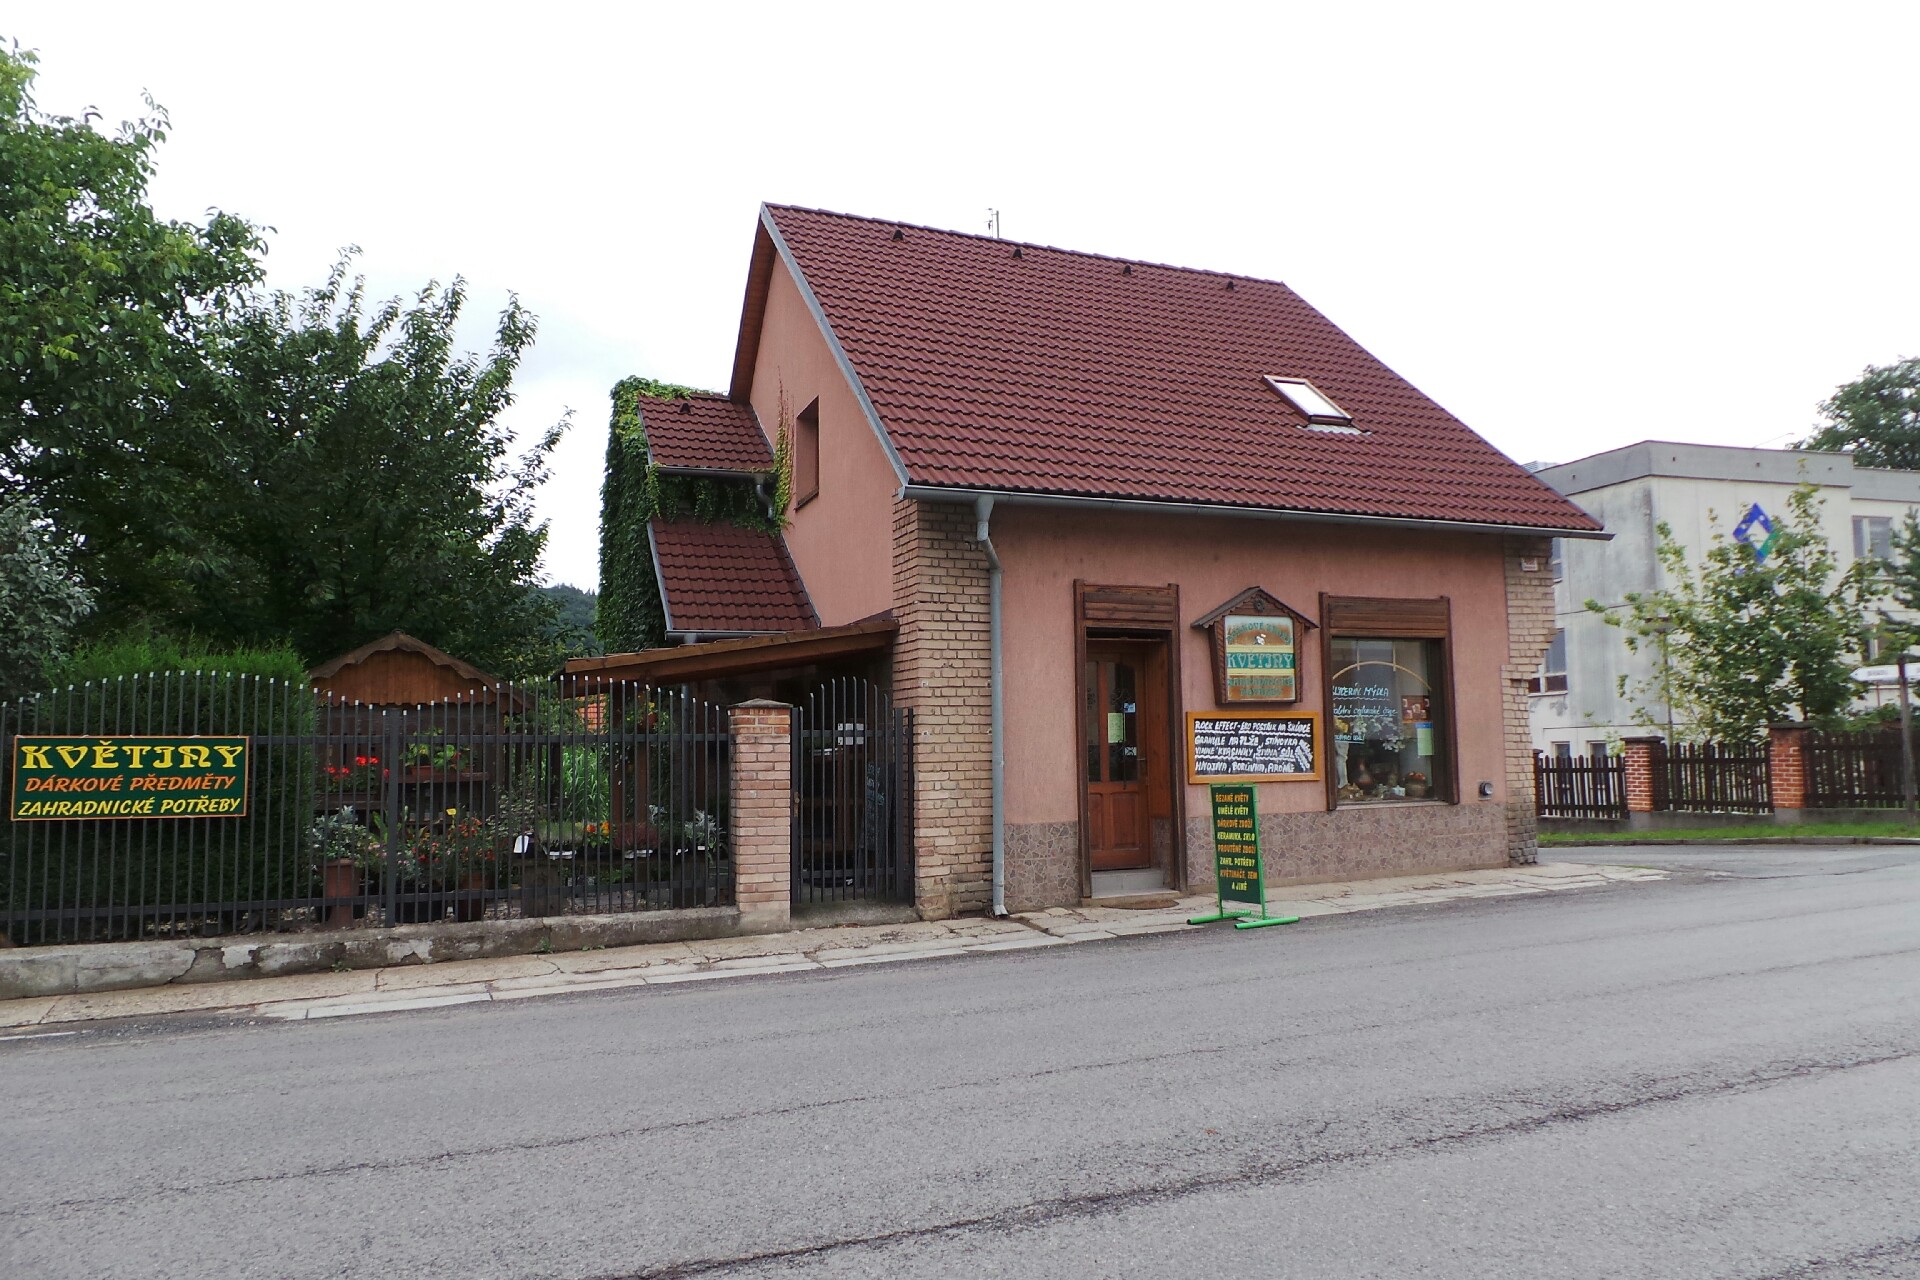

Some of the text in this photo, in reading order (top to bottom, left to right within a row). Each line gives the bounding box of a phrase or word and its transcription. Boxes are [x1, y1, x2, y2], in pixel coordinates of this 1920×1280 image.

[1195, 720, 1213, 730] ROCK
[1229, 736, 1239, 745] NA
[25, 773, 236, 792] DÁRKOVÉ PŘEDMĚTY
[18, 795, 241, 816] ZAHRADNICKÉ POTŘEBY
